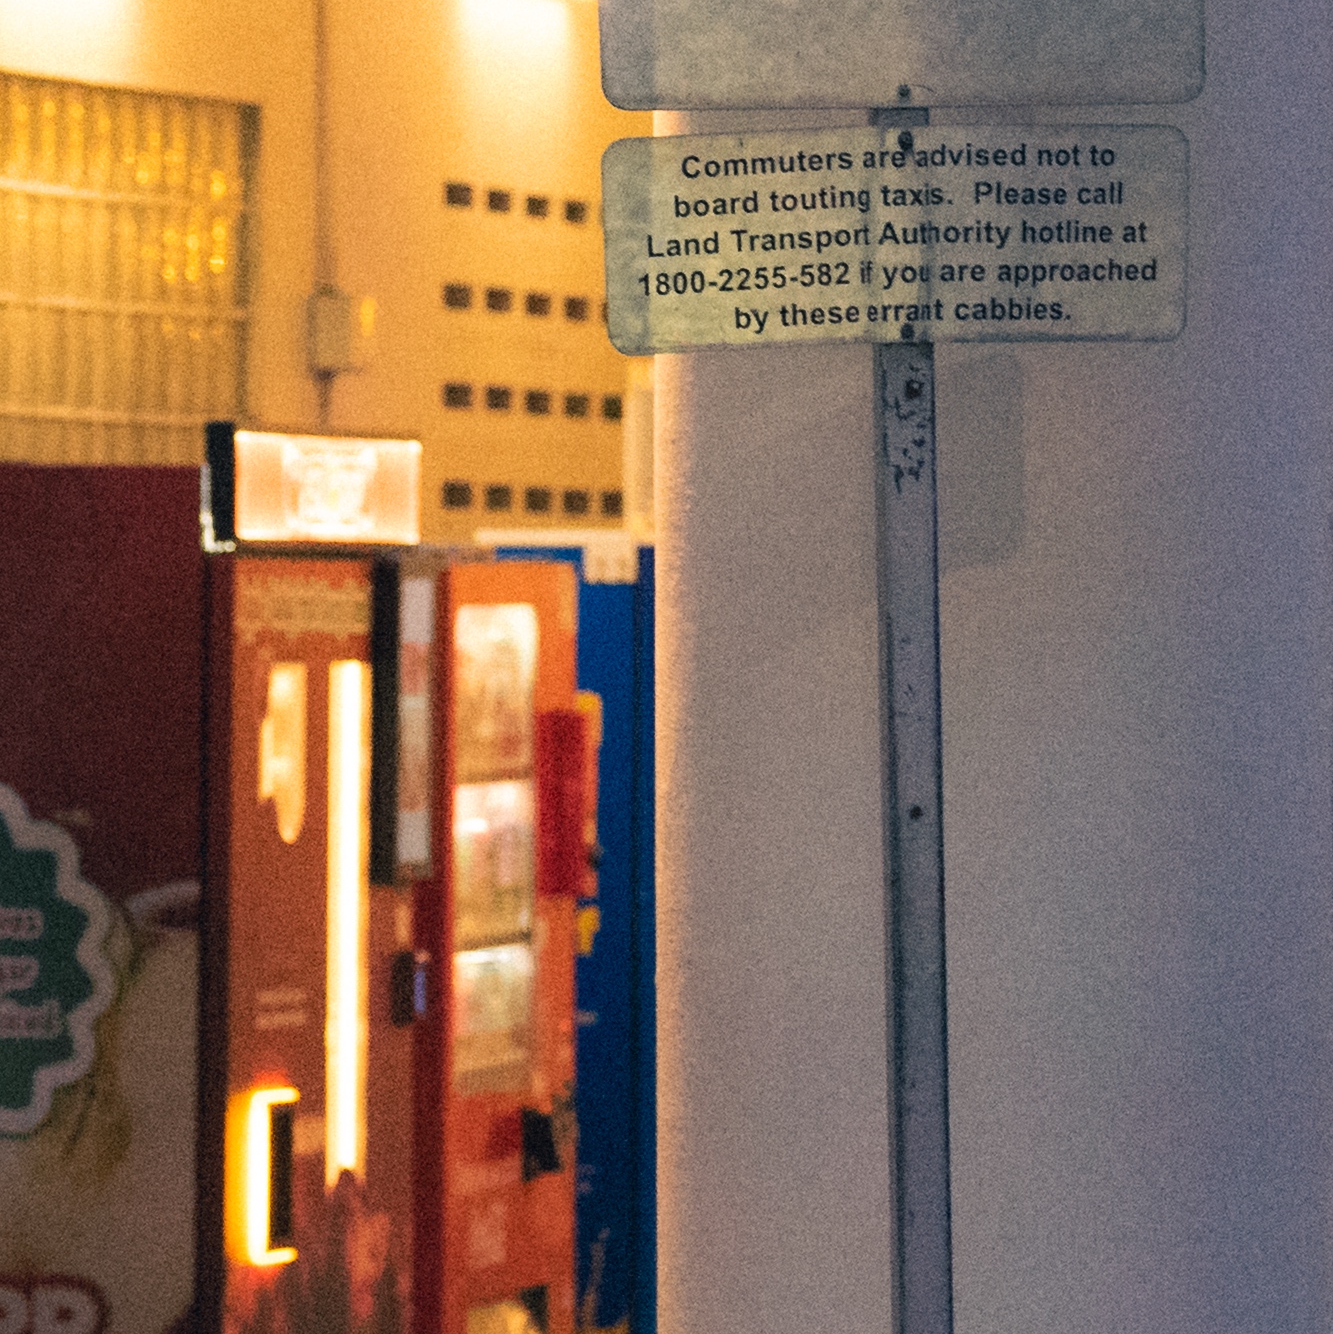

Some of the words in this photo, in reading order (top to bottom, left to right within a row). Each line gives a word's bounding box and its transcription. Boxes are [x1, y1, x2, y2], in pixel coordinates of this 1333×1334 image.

[682, 150, 852, 179] Commuters
[862, 146, 905, 169] are
[914, 143, 1026, 168] advised
[1038, 145, 1080, 167] not
[1089, 145, 1115, 167] to
[674, 191, 758, 217] board
[770, 186, 870, 213] touting
[881, 185, 953, 207] taxis.
[975, 182, 1066, 205] Please
[1078, 181, 1123, 205] call
[647, 231, 719, 258] Land
[730, 225, 870, 254] Transport
[879, 221, 1010, 249] Authority
[1021, 221, 1112, 244] hotline
[1123, 222, 1146, 243] at
[638, 263, 850, 297] 1800-2255-582
[860, 261, 874, 285] if
[882, 265, 930, 289] you
[940, 261, 985, 282] are
[997, 259, 1158, 286] approached
[735, 307, 768, 332] by
[780, 302, 860, 327] these
[867, 300, 944, 322] errant
[955, 297, 1072, 321] cabbies.
